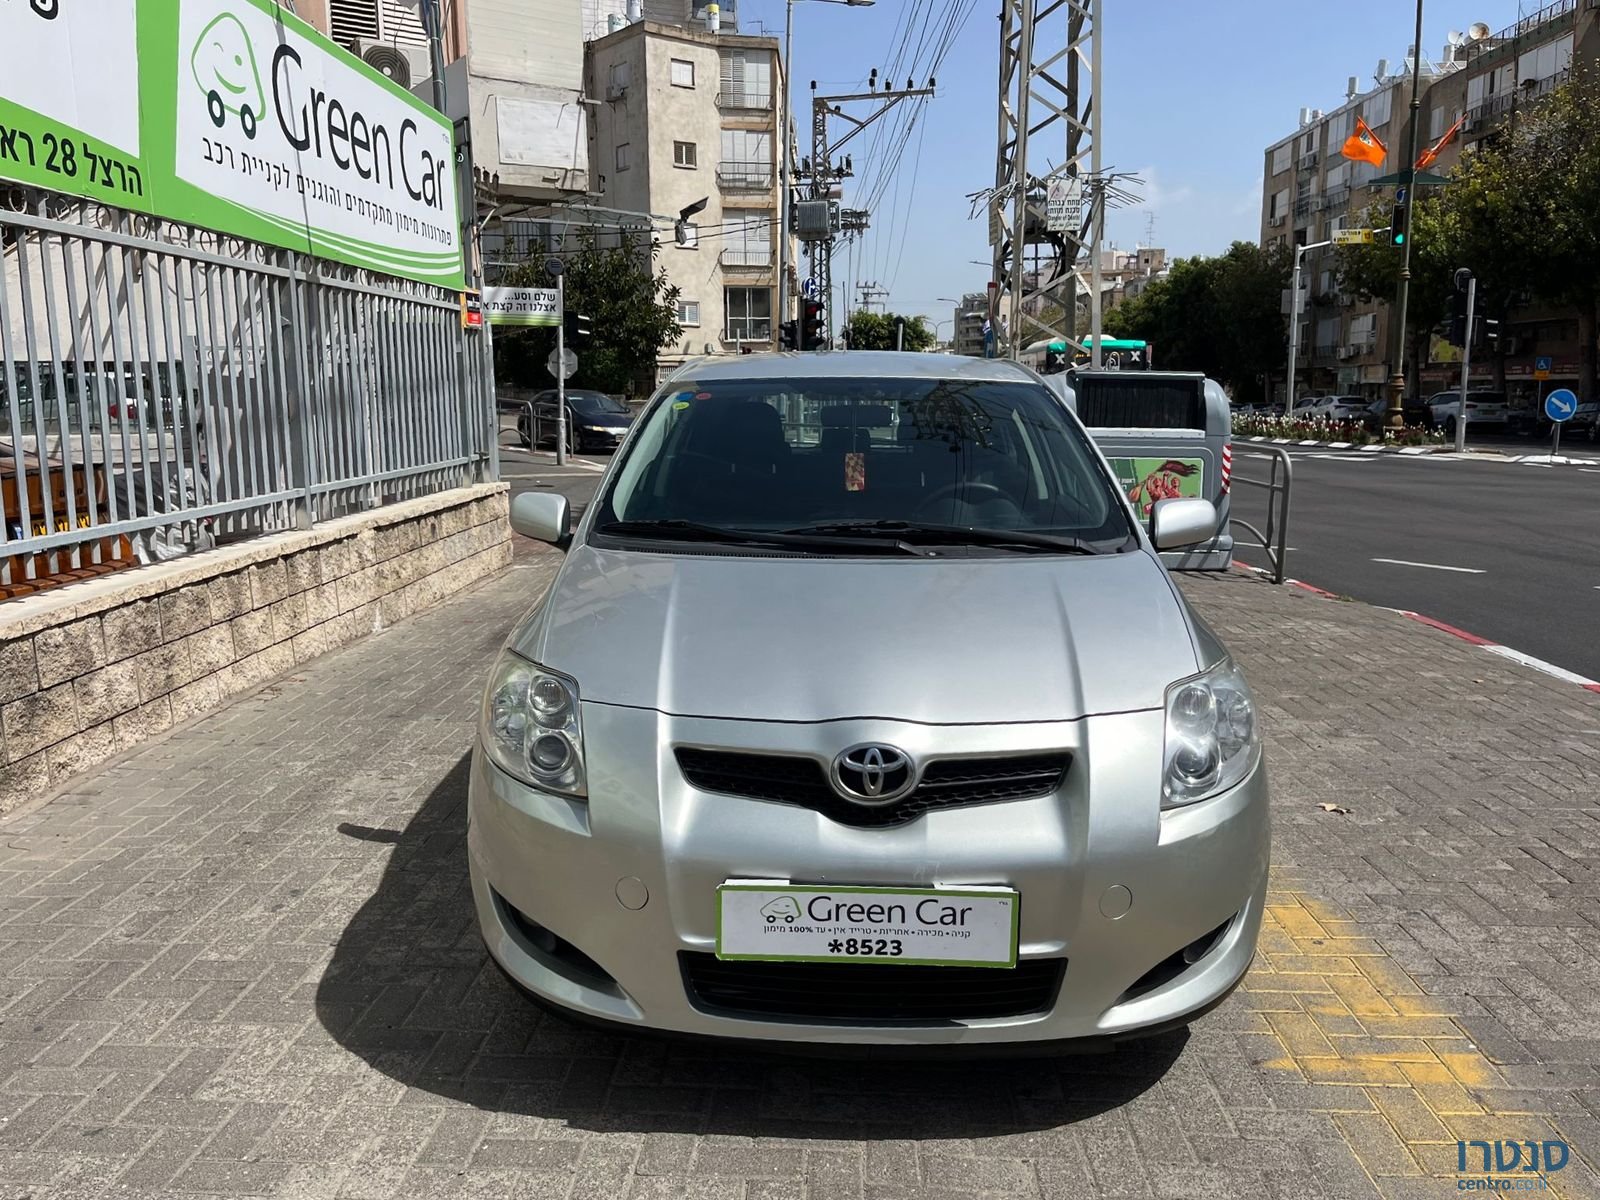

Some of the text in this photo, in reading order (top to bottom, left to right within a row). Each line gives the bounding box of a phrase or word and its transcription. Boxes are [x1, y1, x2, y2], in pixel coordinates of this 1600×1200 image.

[272, 44, 445, 211] Green Car
[42, 132, 77, 177] 28
[83, 142, 142, 196] הרצל
[202, 137, 452, 246] פתרונות מימון מתקדמים והוגנים לקניית רכב
[504, 292, 556, 301] שלם וסע...
[492, 302, 513, 313] קצת
[516, 303, 527, 311] זה
[529, 303, 557, 312] אצלנו
[807, 895, 972, 926] Green Car
[763, 925, 786, 934] מימון
[815, 926, 826, 934] עד
[833, 927, 846, 935] אין
[849, 927, 872, 935] טרייד
[879, 927, 910, 936] אחריות
[917, 929, 944, 937] מכירה
[951, 931, 971, 939] קניה
